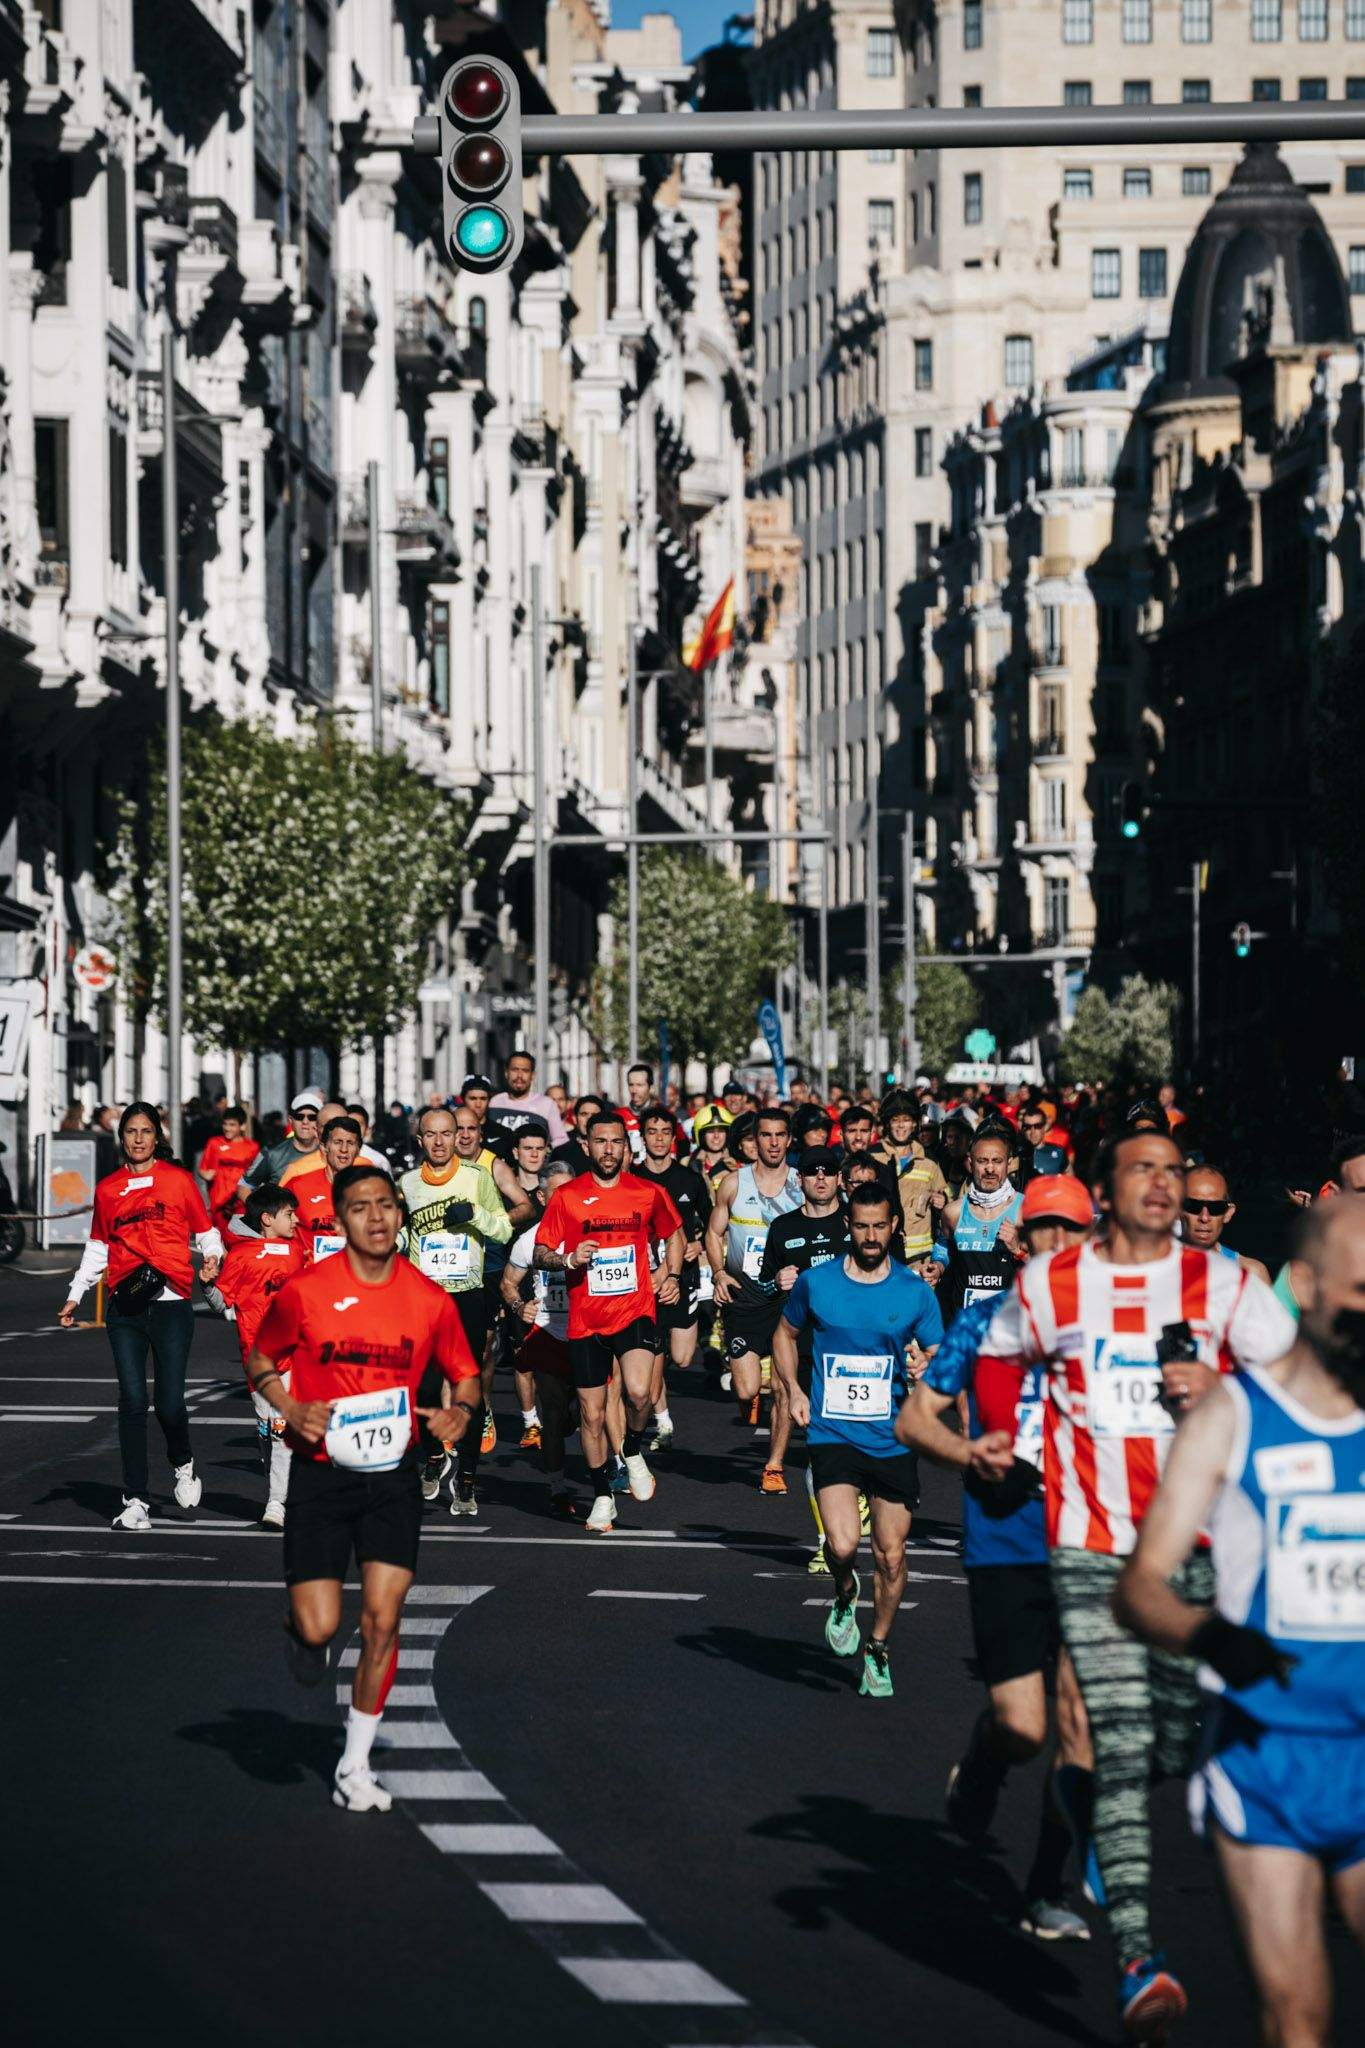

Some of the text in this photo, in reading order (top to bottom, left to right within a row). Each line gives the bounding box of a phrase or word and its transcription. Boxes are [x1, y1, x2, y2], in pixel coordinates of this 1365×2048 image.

[431, 1253, 457, 1265] 442
[597, 1266, 630, 1282] 1594
[968, 1275, 1002, 1286] NEGRI
[847, 1384, 870, 1401] 53
[351, 1426, 392, 1450] 179
